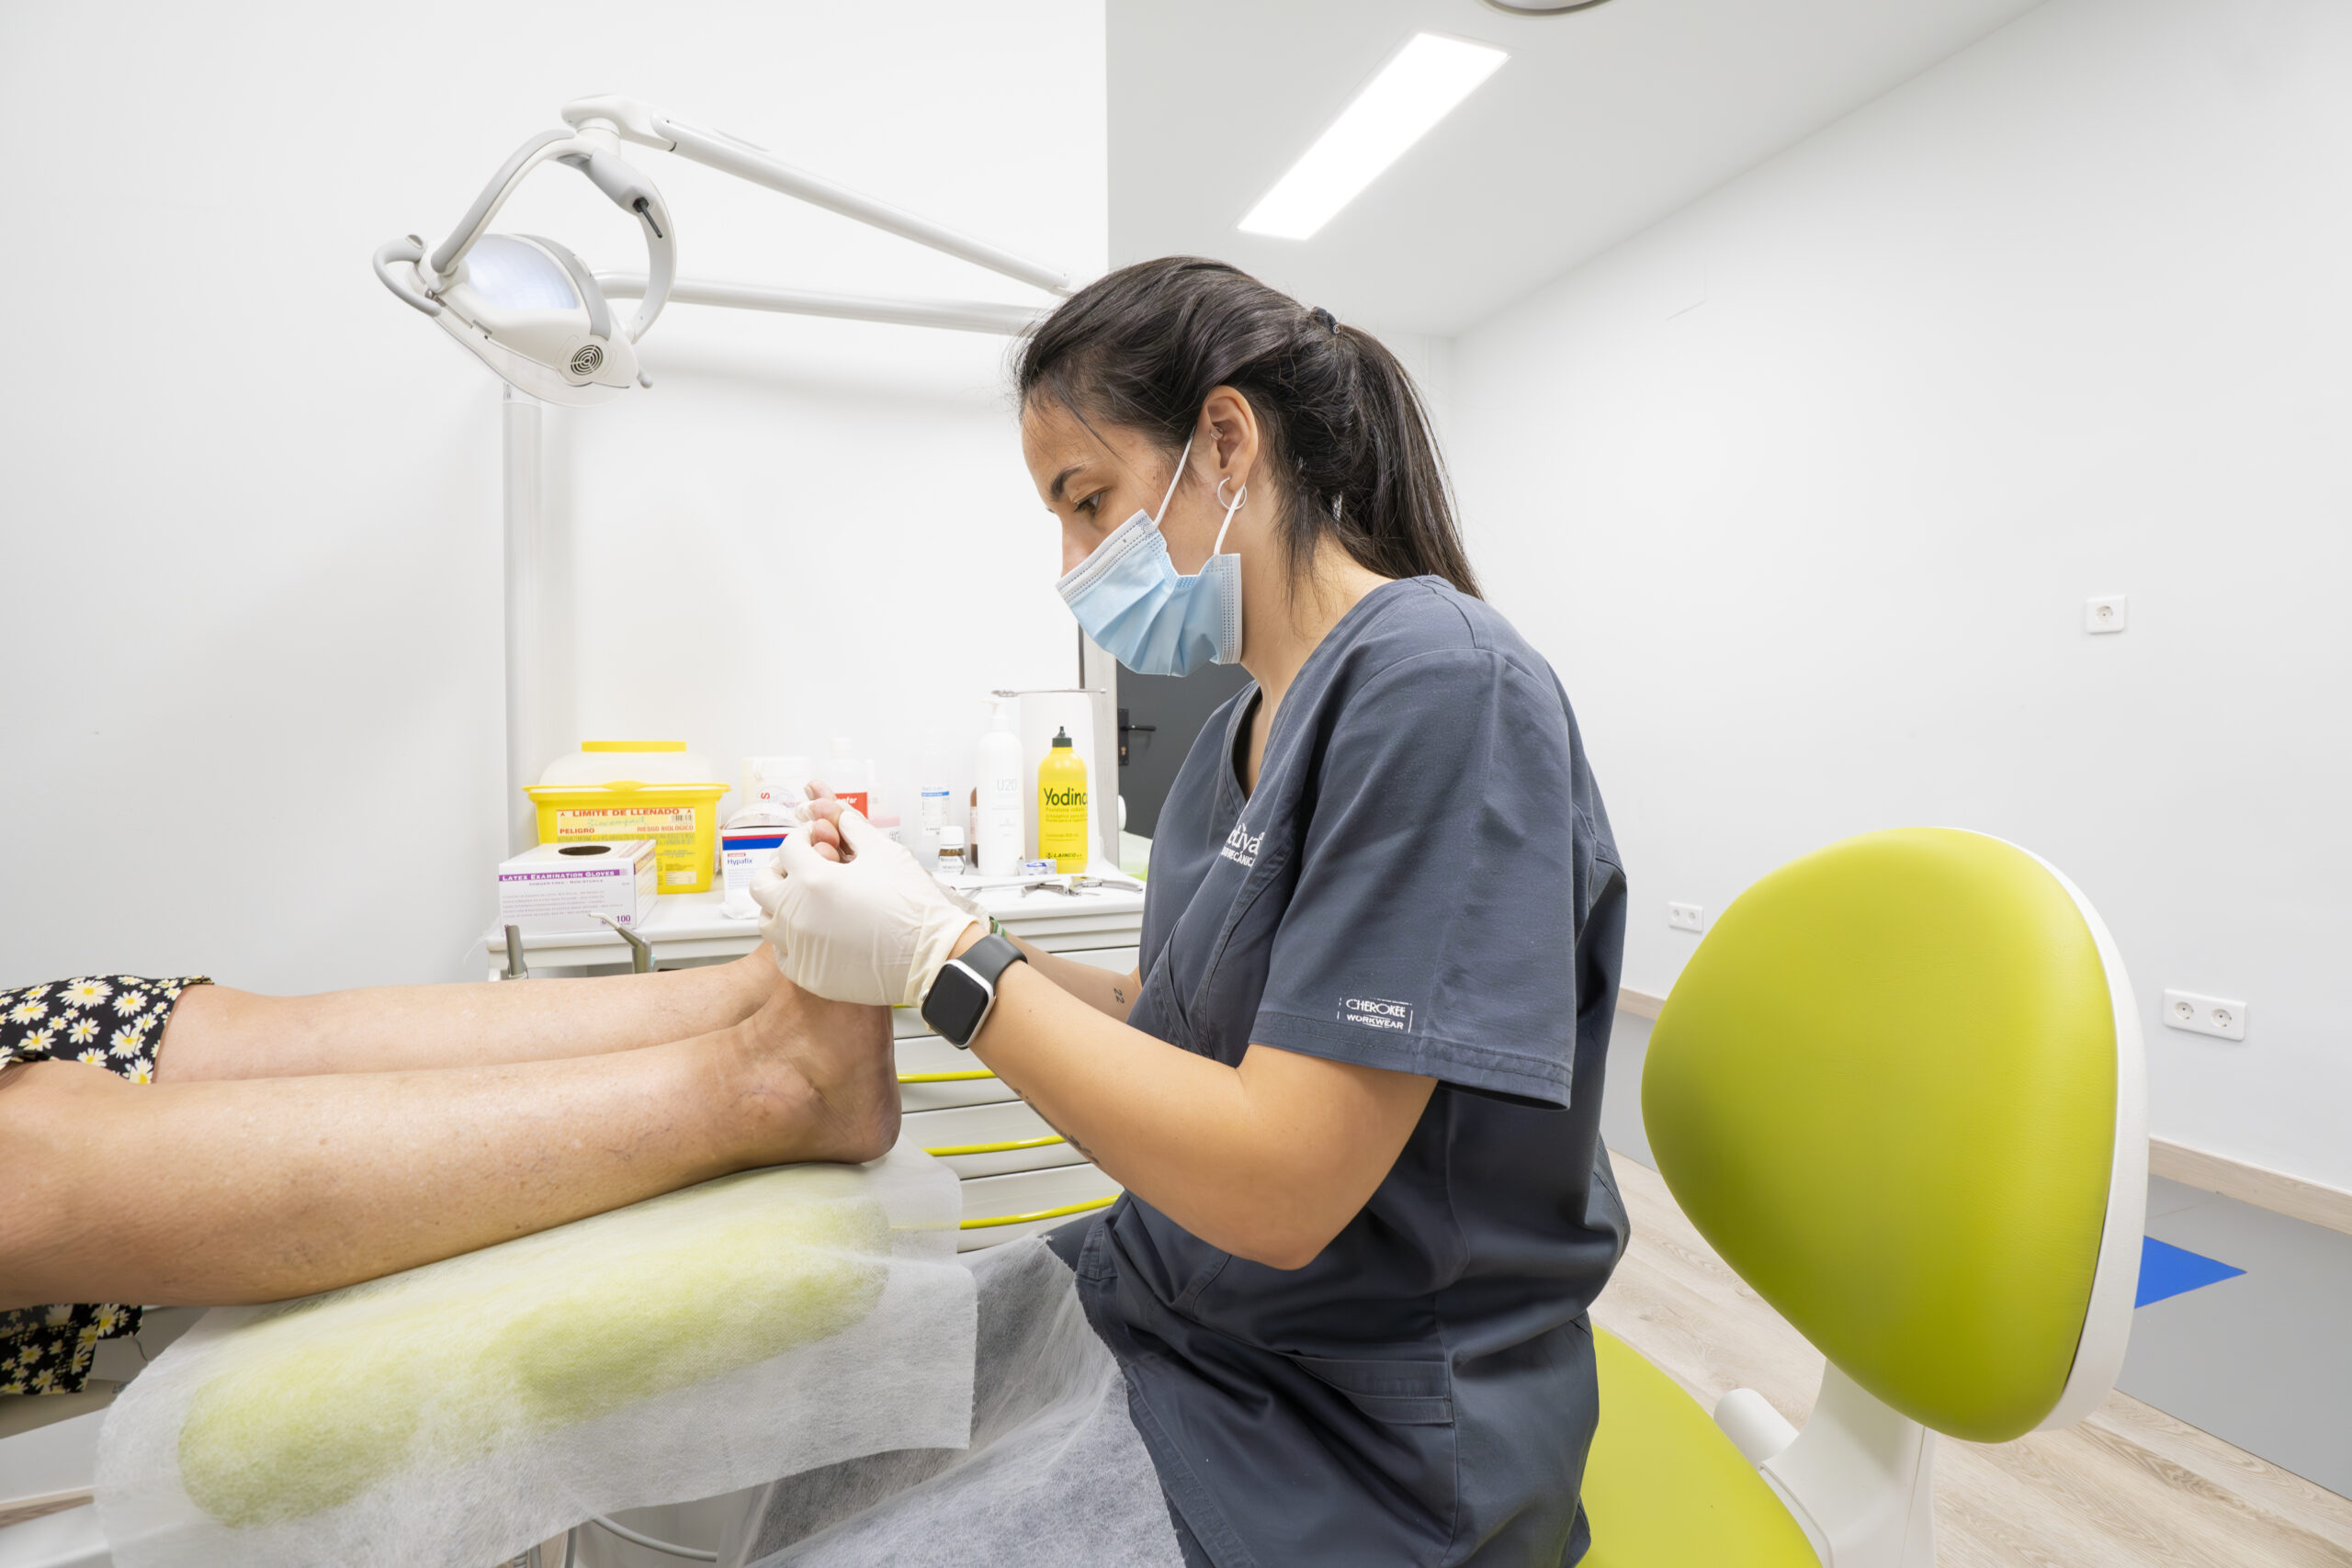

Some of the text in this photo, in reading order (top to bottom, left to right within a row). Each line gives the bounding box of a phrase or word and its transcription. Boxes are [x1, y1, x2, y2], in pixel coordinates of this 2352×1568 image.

[612, 808, 627, 817] DE
[630, 807, 680, 816] LLENADO
[728, 858, 752, 866] Hypafix
[616, 915, 631, 923] 100
[1346, 998, 1406, 1018] CHEROKEE
[1346, 1013, 1404, 1030] WORKWEAR
